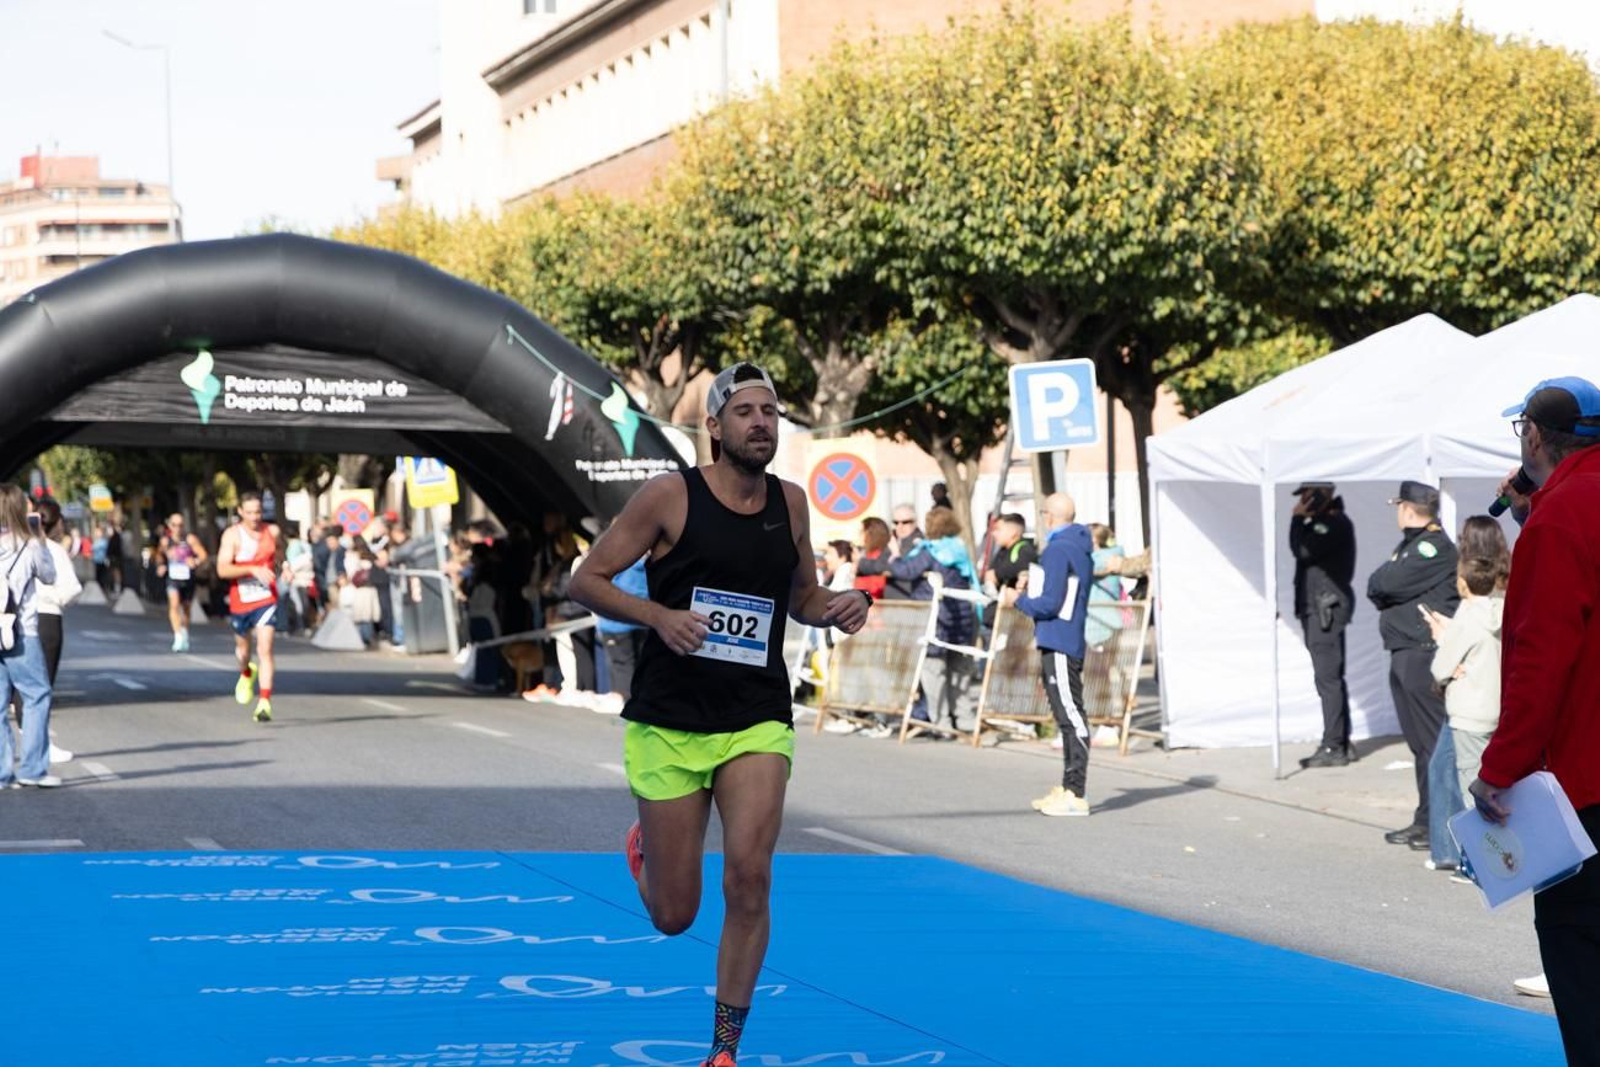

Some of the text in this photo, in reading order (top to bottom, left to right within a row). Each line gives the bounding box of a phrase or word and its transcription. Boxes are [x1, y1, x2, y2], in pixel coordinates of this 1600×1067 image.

[224, 375, 408, 398] Patronato Municipal de
[224, 393, 366, 413] Deportes de Jaén
[1027, 372, 1080, 441] P
[708, 610, 759, 639] 602
